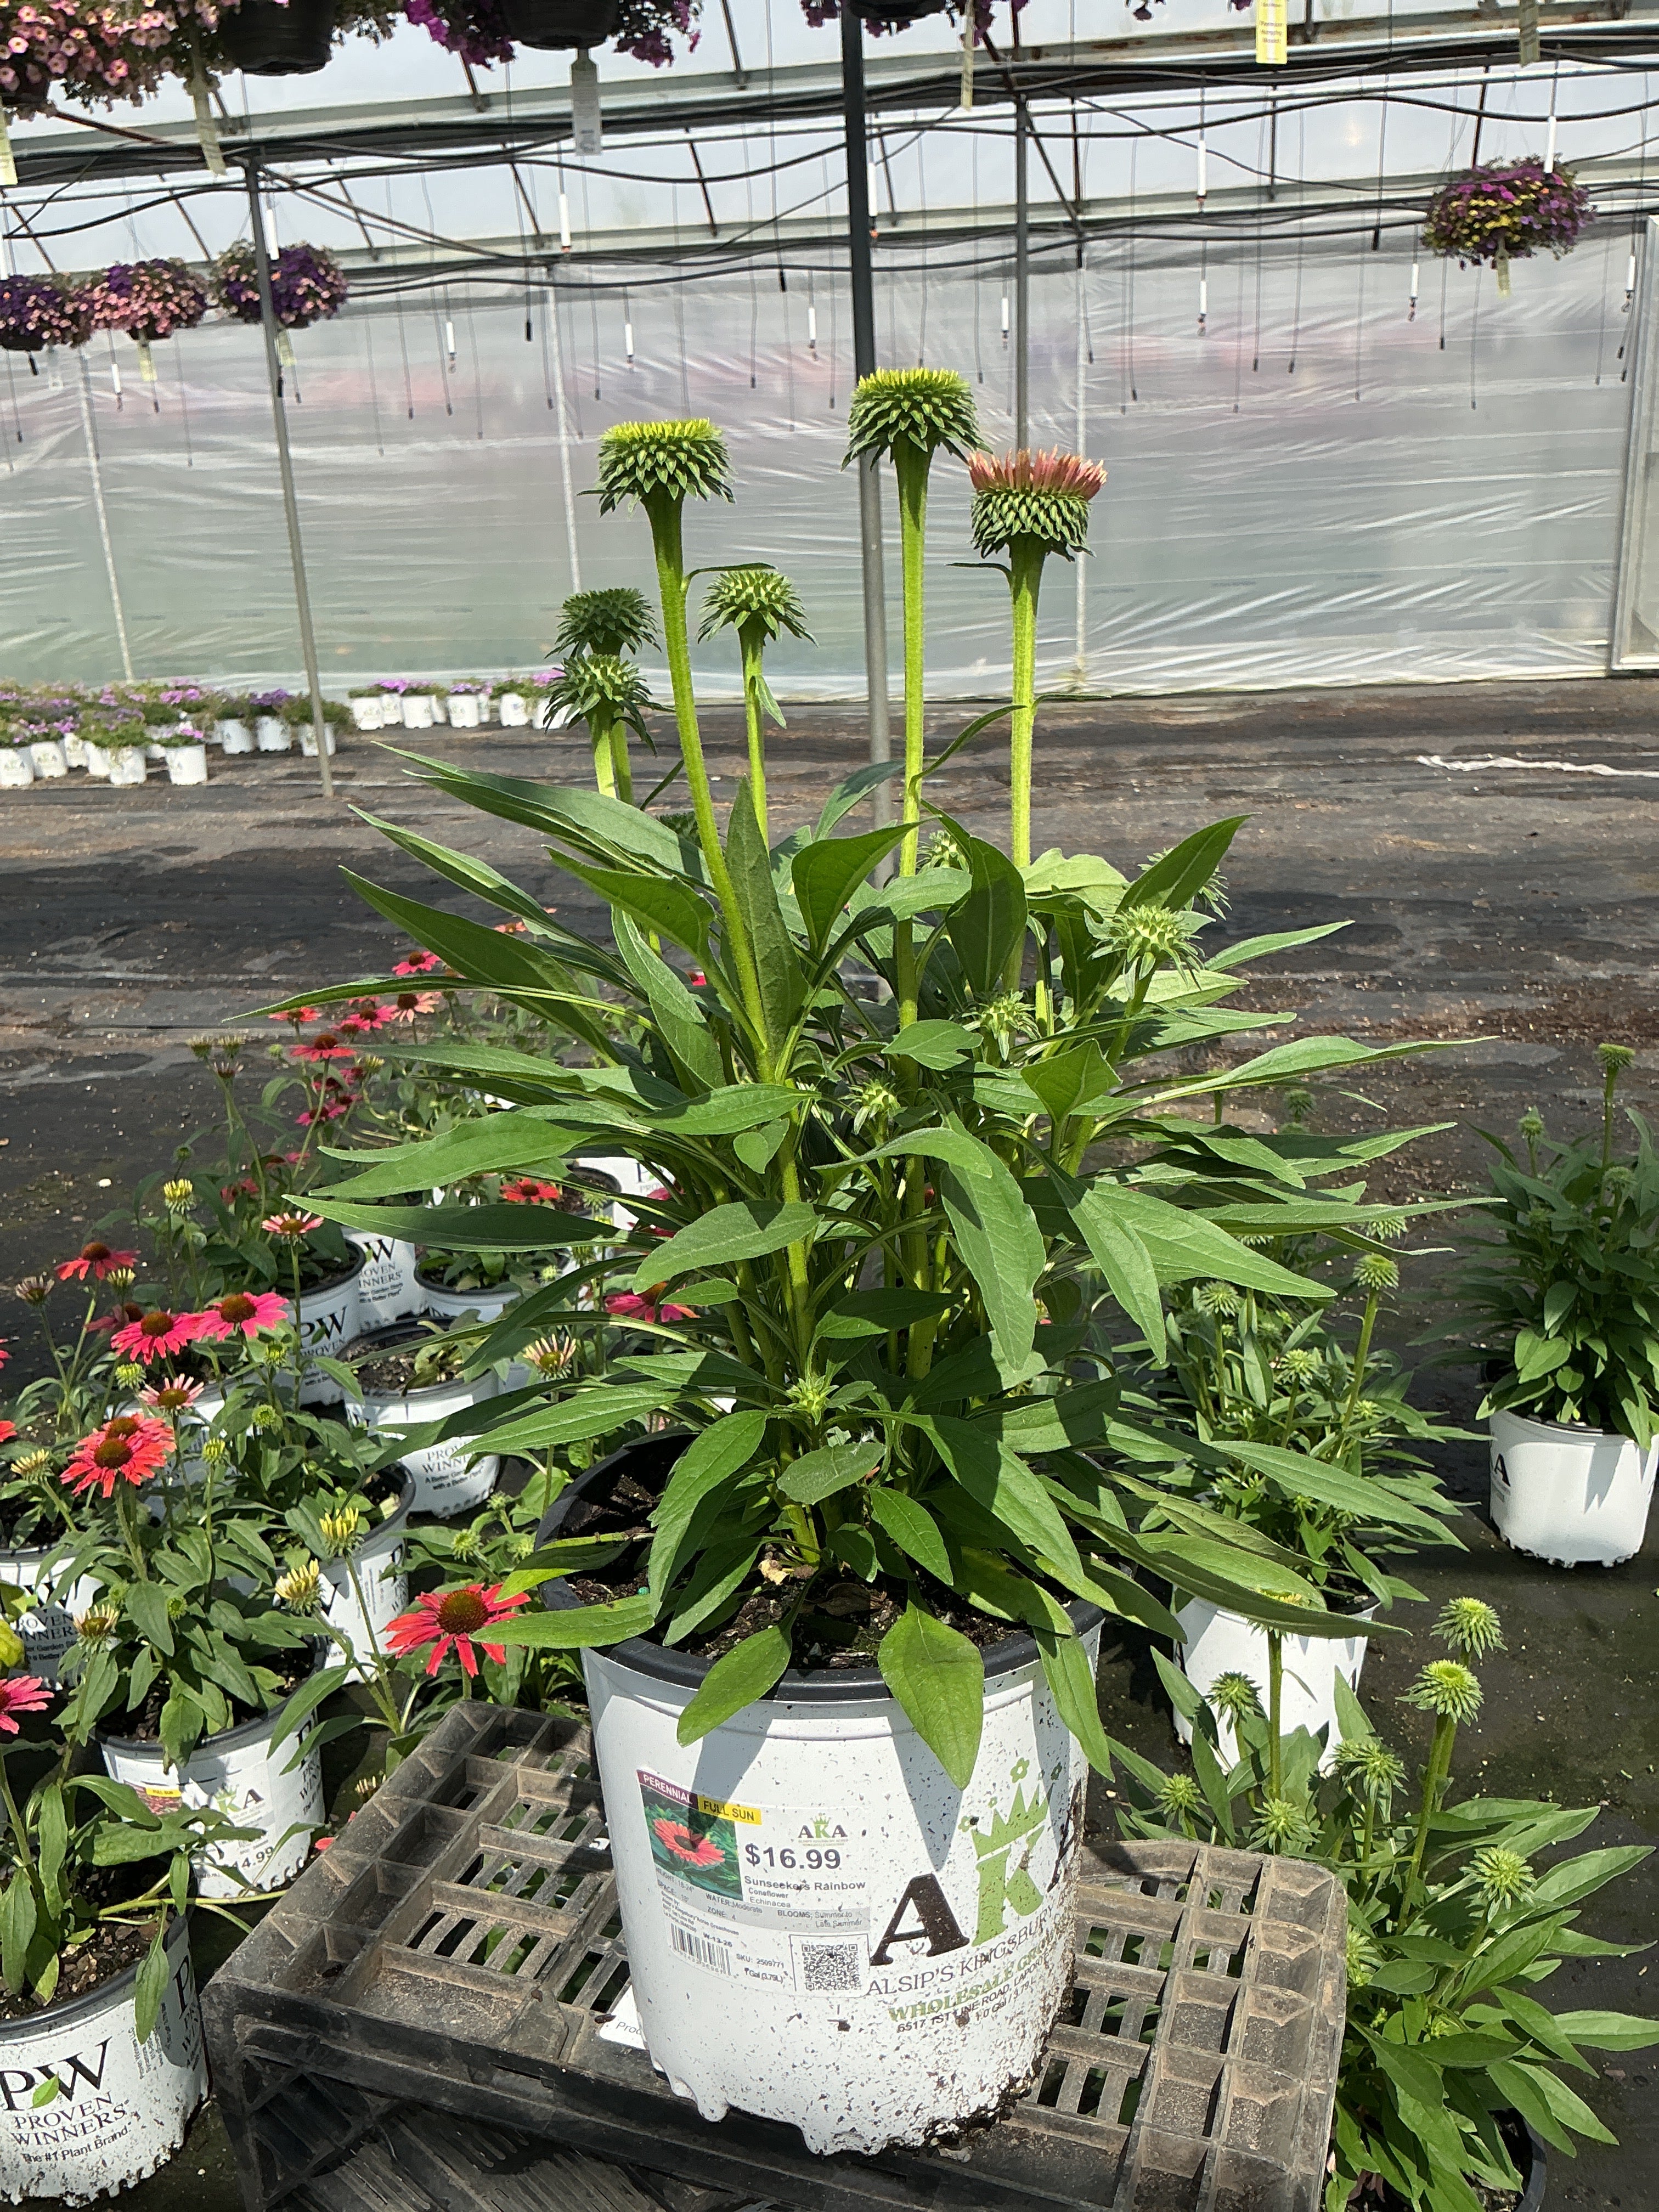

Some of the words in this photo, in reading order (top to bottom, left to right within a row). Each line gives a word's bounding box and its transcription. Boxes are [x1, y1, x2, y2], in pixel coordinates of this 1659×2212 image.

[643, 1774, 693, 1805] PERENNIAL
[703, 1800, 730, 1816] FULL
[731, 1808, 755, 1821] SUN
[798, 1824, 848, 1838] AKA
[744, 1842, 841, 1870] $16.99
[744, 1875, 810, 1891] Sunseekers
[814, 1881, 866, 1891] Rainbow
[748, 1887, 789, 1899] Coneflower
[749, 1897, 791, 1908] Echinacea
[777, 1909, 813, 1918] BLOOMS:
[736, 1953, 753, 1963] SKU:
[866, 1965, 955, 1996] ALSIP'S
[960, 1905, 1054, 1977] KINGSBURY
[888, 1960, 1014, 2023] WHOLESALE
[896, 2018, 926, 2034] 6517
[0, 2036, 112, 2111] PW
[13, 2090, 112, 2130] PROVEN
[10, 2103, 126, 2146] WINNERS
[20, 2152, 42, 2163] The
[44, 2151, 59, 2162] #1
[61, 2142, 93, 2160] Plant
